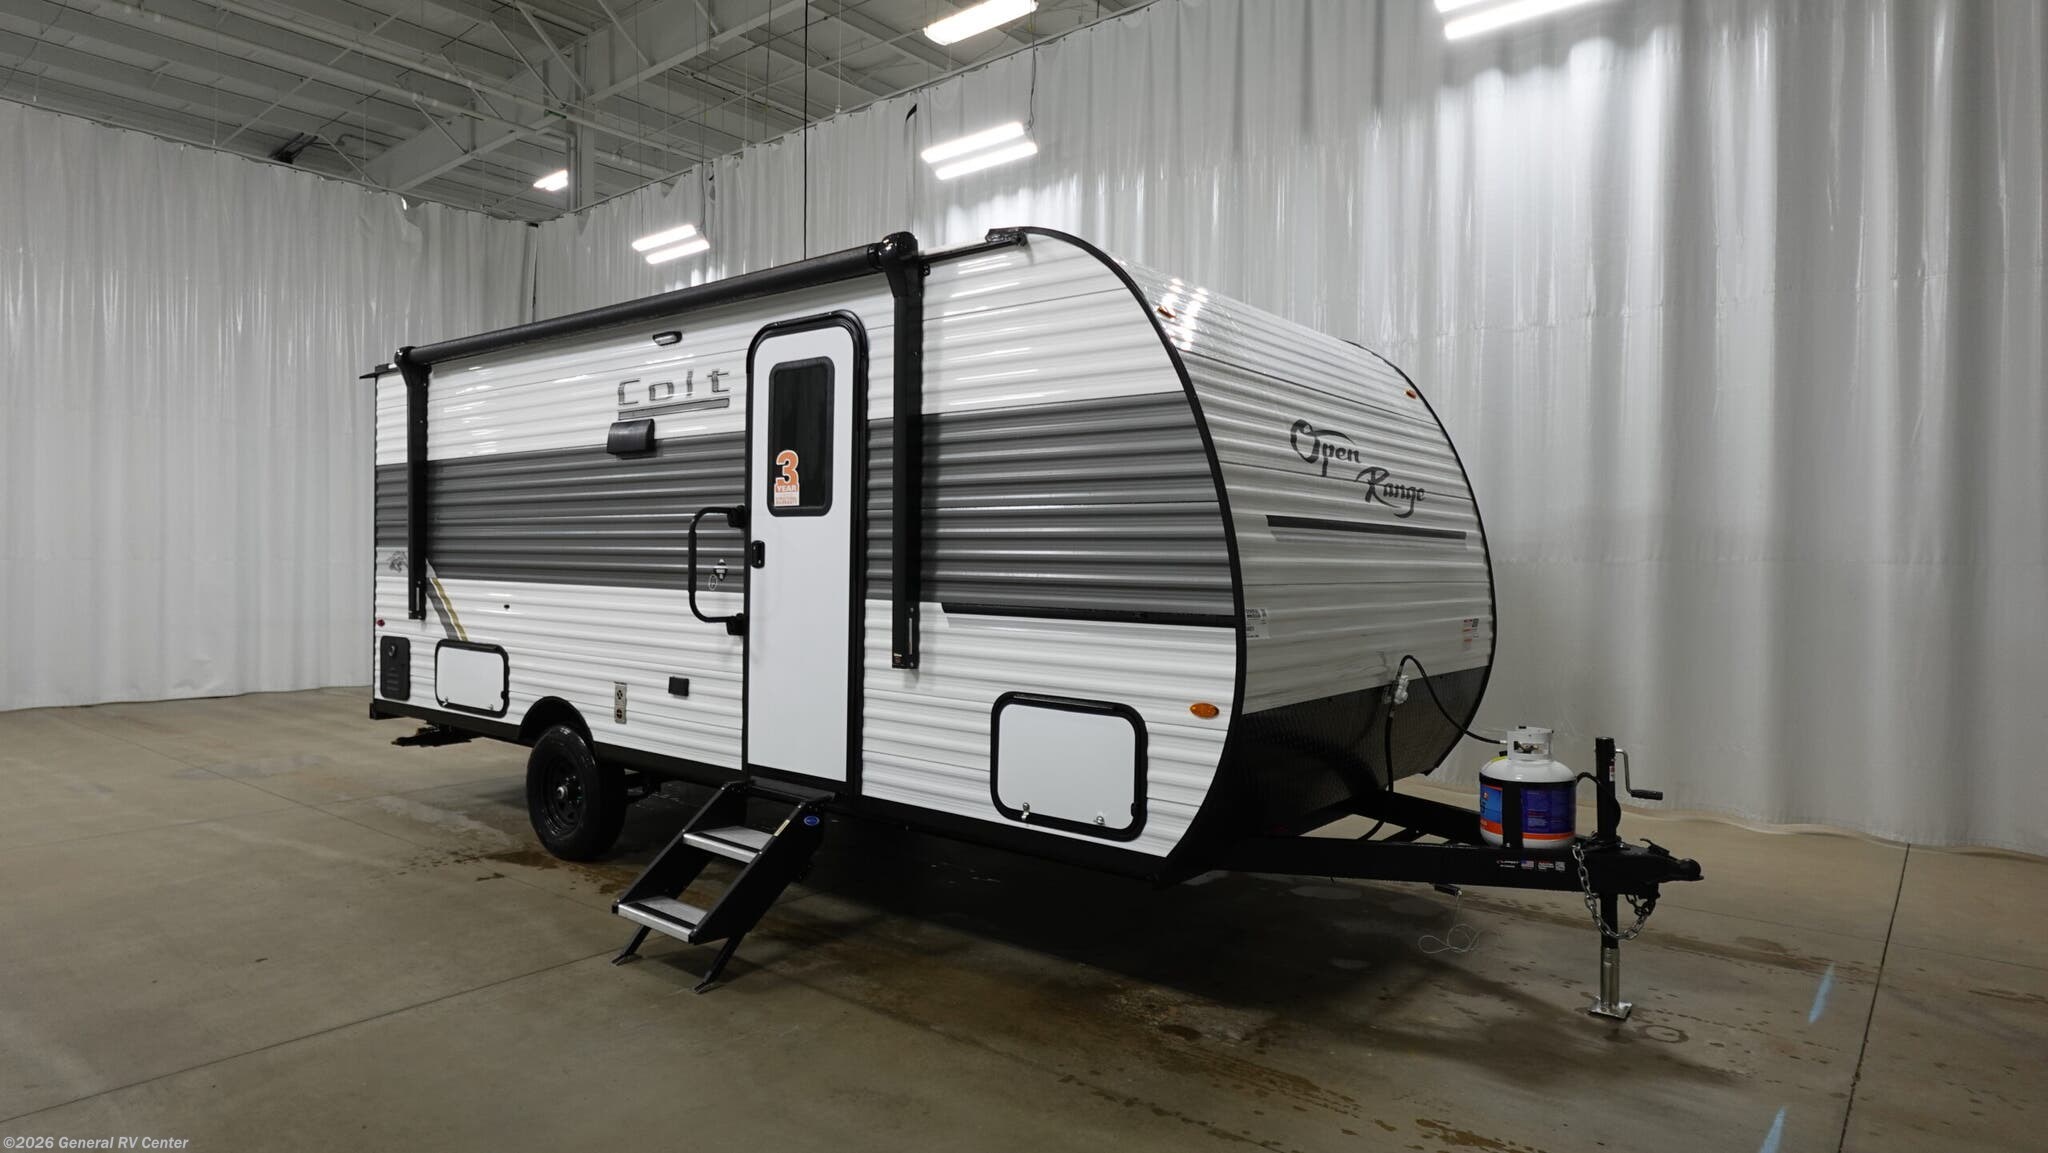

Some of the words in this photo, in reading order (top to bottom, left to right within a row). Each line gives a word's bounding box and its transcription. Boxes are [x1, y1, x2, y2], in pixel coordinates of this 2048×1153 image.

[617, 370, 730, 406] Colt
[1290, 418, 1361, 477] Open
[776, 449, 799, 486] 3
[776, 485, 798, 493] YEAR
[1354, 466, 1425, 518] Range
